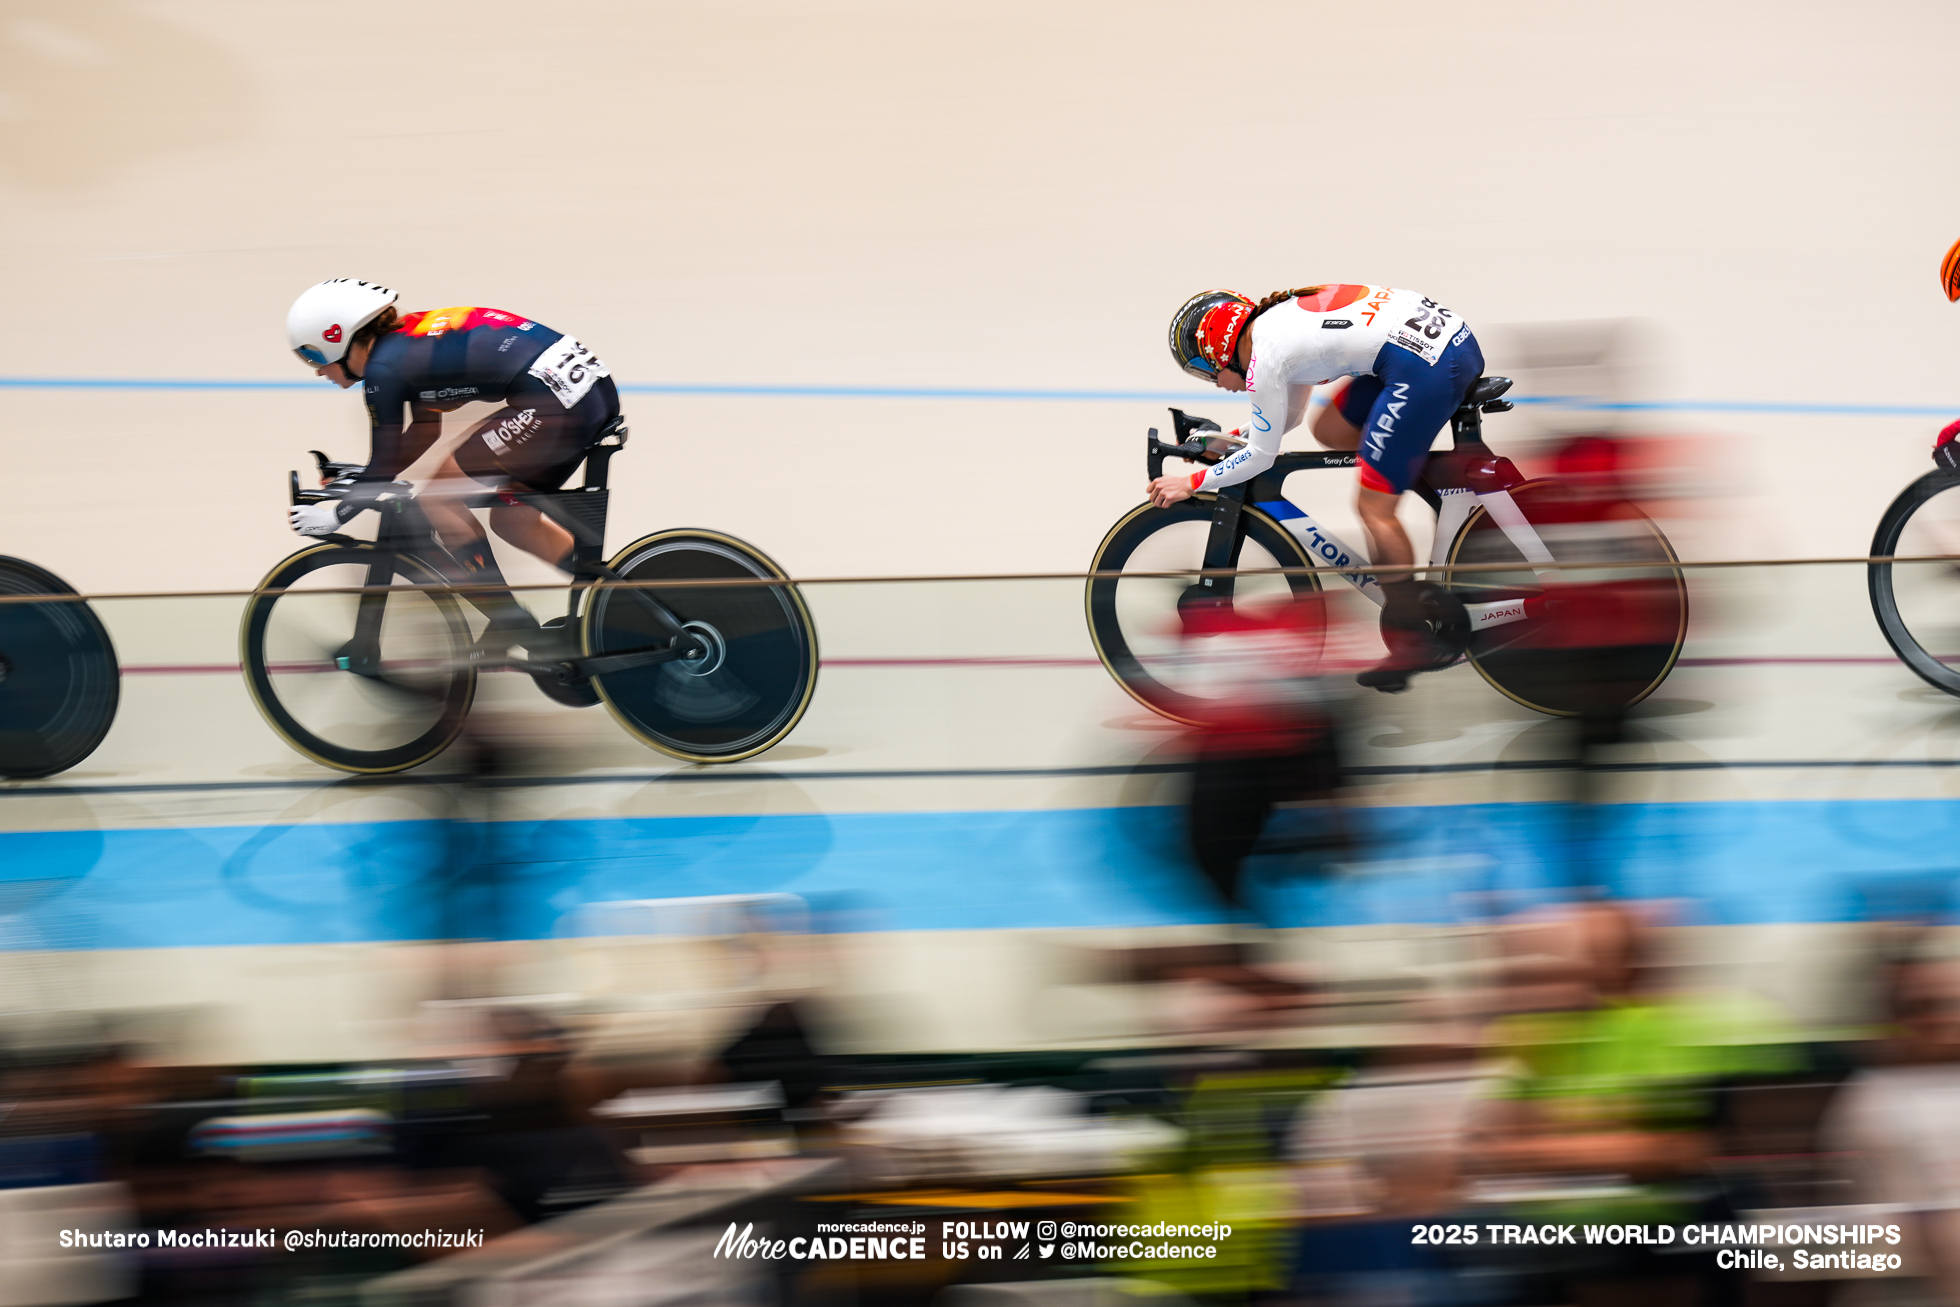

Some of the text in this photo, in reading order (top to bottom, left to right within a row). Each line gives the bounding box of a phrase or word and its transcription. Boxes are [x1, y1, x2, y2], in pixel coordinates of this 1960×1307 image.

[1221, 304, 1244, 351] JAPAN
[1404, 306, 1446, 340] 28
[1409, 334, 1434, 351] TISSOT
[557, 353, 590, 384] 16
[498, 408, 537, 442] O'SHEA
[516, 419, 543, 445] RACING
[1364, 382, 1411, 462] JAPAN
[1323, 457, 1343, 466] Toray
[1480, 608, 1521, 621] JAPAN
